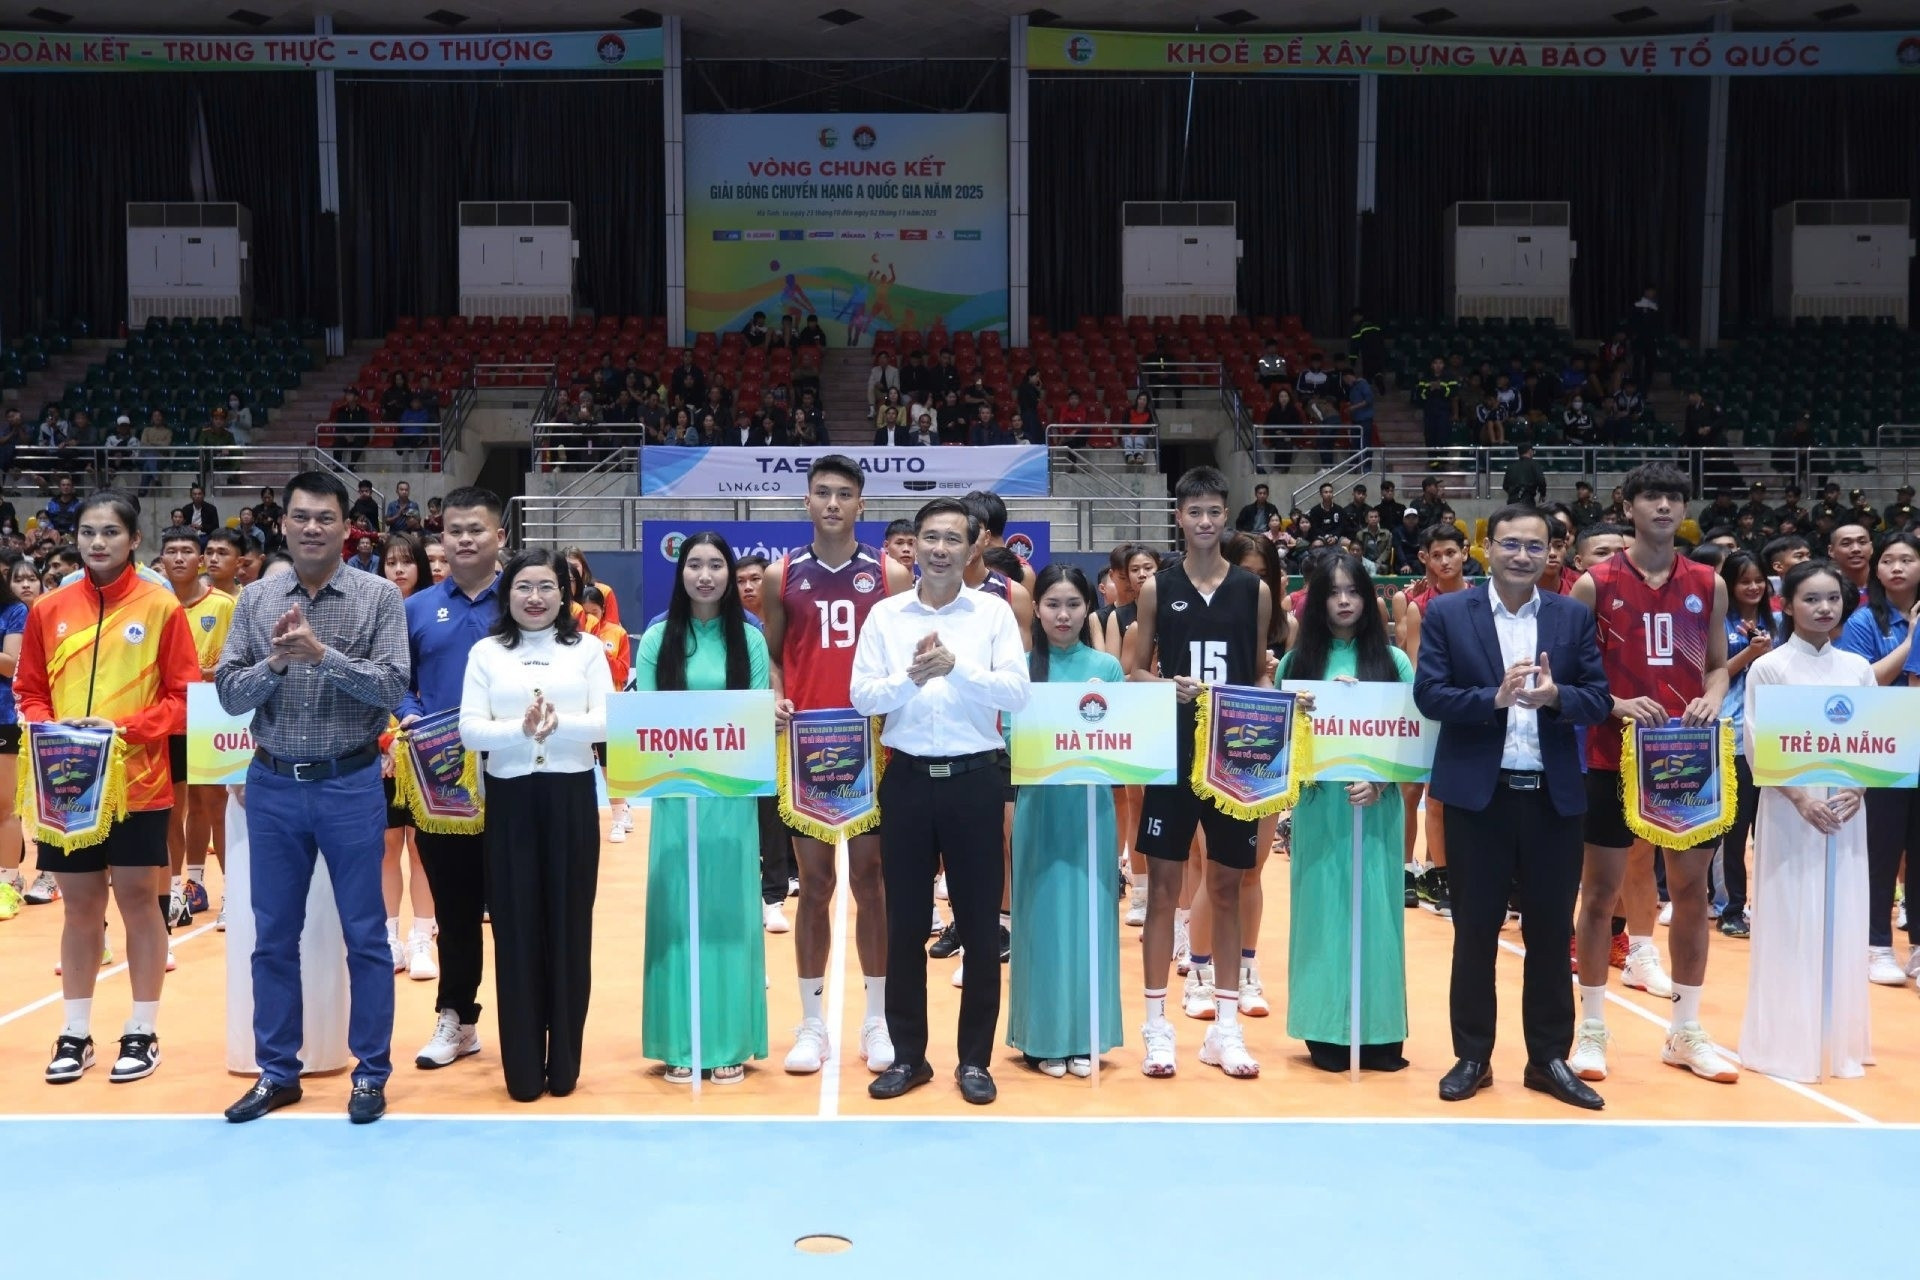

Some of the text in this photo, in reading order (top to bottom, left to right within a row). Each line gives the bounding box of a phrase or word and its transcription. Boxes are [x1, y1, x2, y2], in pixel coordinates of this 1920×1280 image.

[84, 36, 130, 62] KẾT
[164, 42, 254, 62] TRUNG
[265, 39, 336, 67] THỰC
[370, 41, 429, 62] CAO
[439, 39, 553, 67] THƯỢNG
[1167, 36, 1820, 73] KHOẺ ĐỂ XÂY DỰNG VÀ BẢO VỆ TỔ QUỐC
[748, 154, 946, 177] VÒNG CHUNG KẾT
[821, 184, 853, 202] HẠNG
[856, 185, 864, 199] A
[867, 179, 898, 200] QUỐC
[902, 184, 921, 199] GIA
[925, 182, 951, 199] NĂM
[954, 185, 983, 199] 2025
[860, 457, 925, 473] AUTO
[938, 482, 974, 491] GEELY
[814, 599, 856, 649] 19
[1642, 612, 1673, 657] 10
[1189, 641, 1228, 686] 15
[1311, 714, 1420, 737] HÁI NGUYÊN
[636, 723, 746, 758] TRỌNG TÀI
[1055, 729, 1132, 751] HÀ TĨNH
[1779, 730, 1896, 754] TRẺ ĐÀ NẴNG
[1147, 817, 1163, 836] 15
